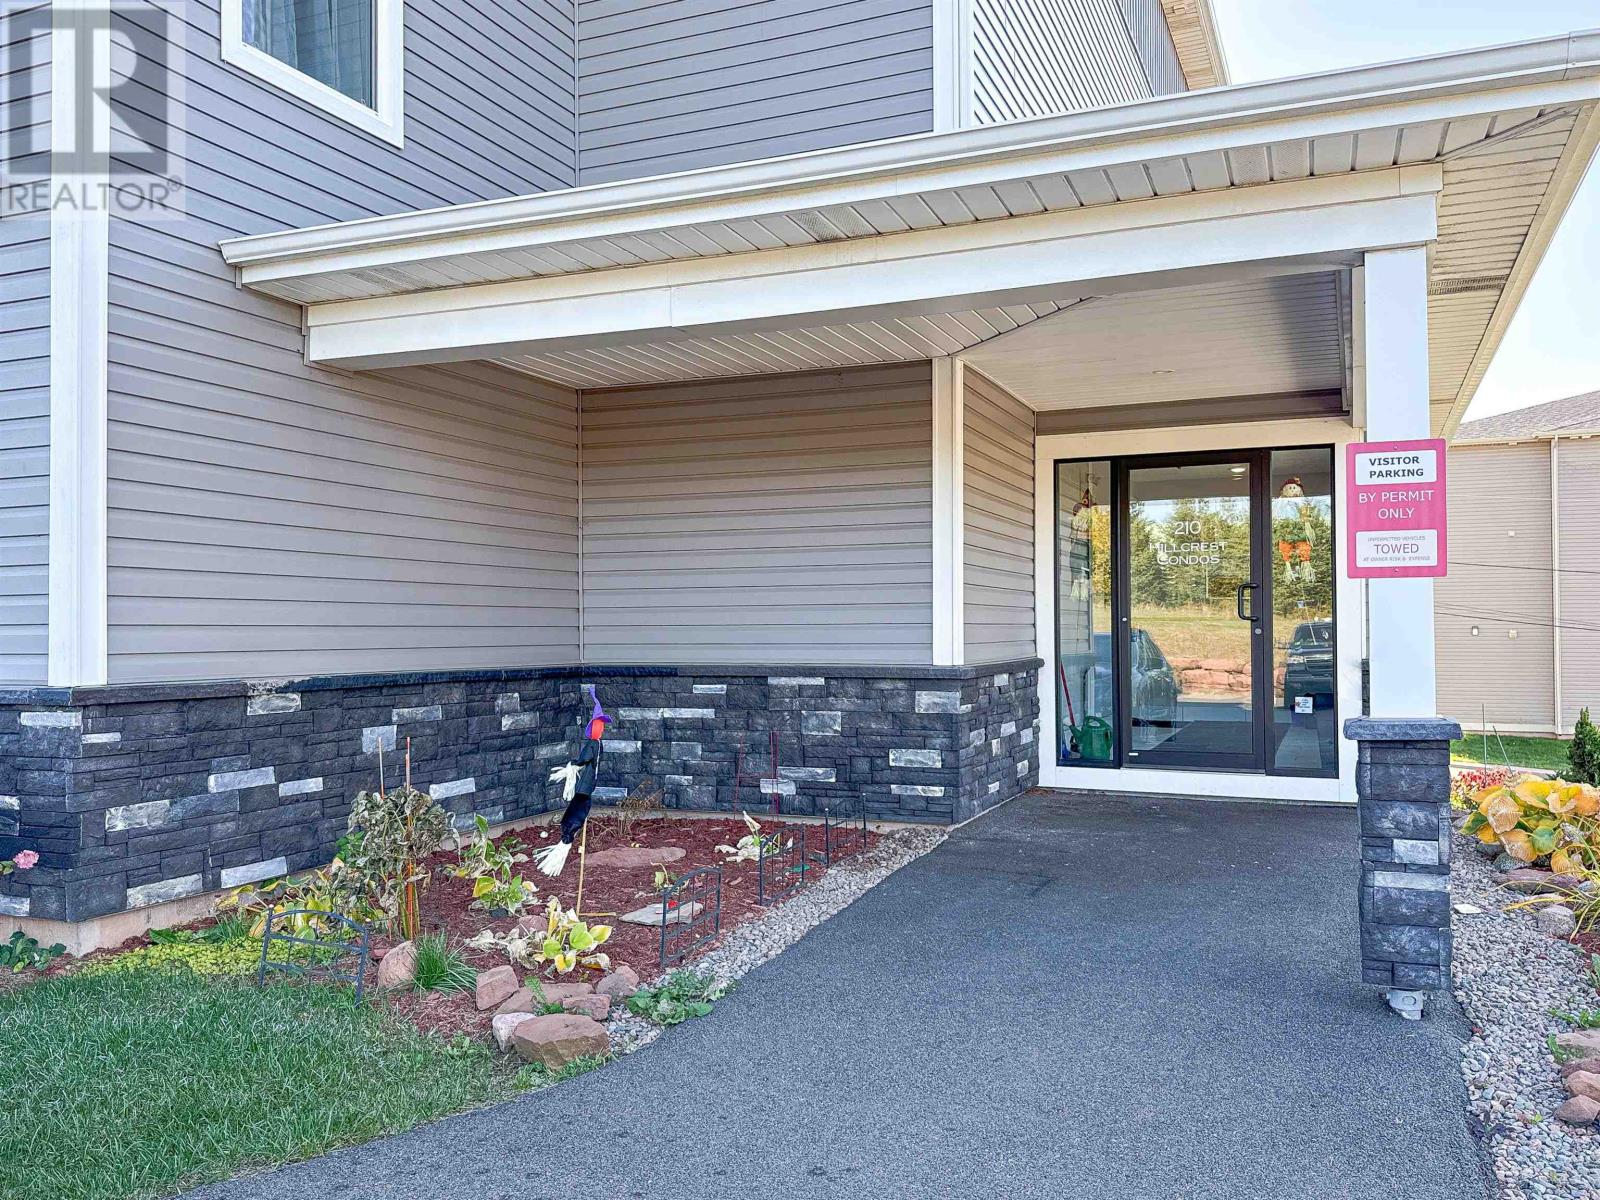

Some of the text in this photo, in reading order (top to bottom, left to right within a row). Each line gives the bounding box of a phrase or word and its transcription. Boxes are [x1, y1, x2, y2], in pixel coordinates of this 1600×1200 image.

[1369, 456, 1420, 466] VISITOR
[1369, 468, 1424, 478] PARKING
[1359, 490, 1434, 503] BY PERMIT
[1378, 508, 1415, 519] ONLY
[1174, 520, 1201, 535] 210
[1148, 541, 1228, 553] HILLCREST
[1373, 543, 1419, 555] TOWED
[1156, 554, 1220, 565] CONDOS
